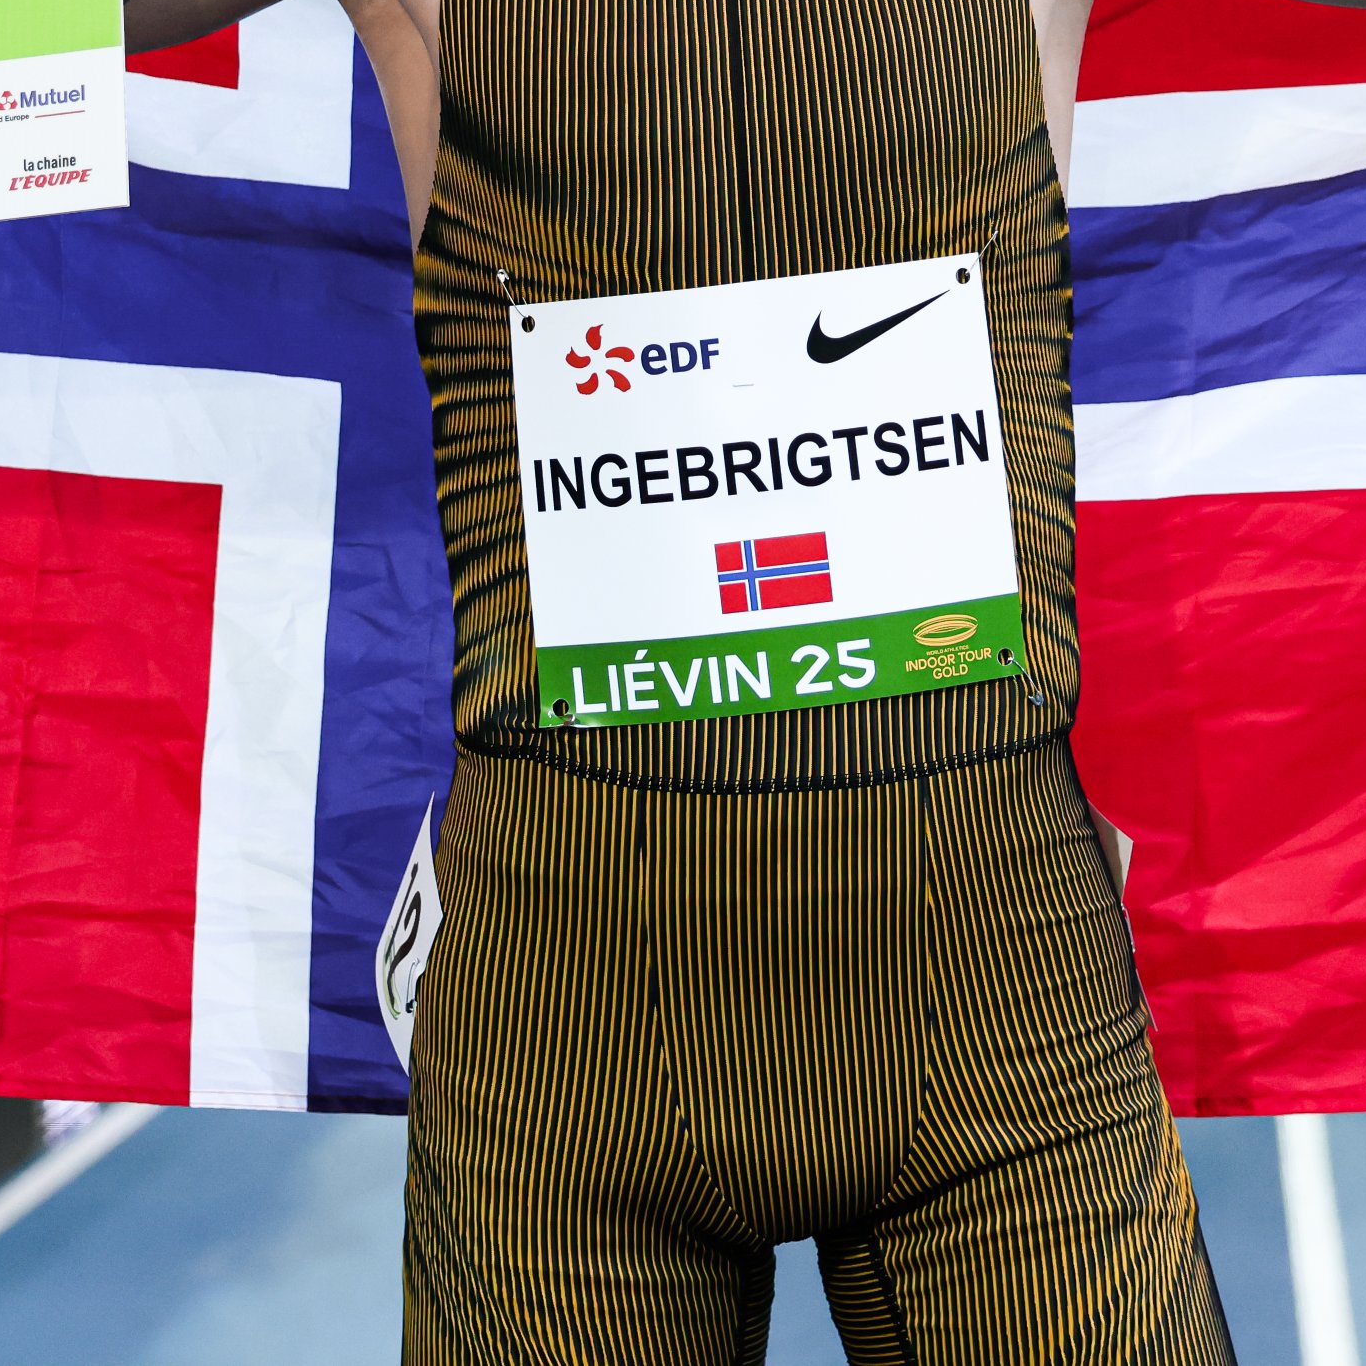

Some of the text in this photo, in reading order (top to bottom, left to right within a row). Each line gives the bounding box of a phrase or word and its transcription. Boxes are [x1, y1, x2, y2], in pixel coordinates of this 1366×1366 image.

[20, 84, 86, 109] Mutuel
[5, 113, 30, 124] Europe
[23, 158, 34, 172] la
[533, 409, 990, 513] INGEBRIGTSEN
[905, 647, 992, 672] INDOOR TOUR
[932, 664, 969, 680] GOLD
[571, 638, 877, 715] LIÉVIN 25
